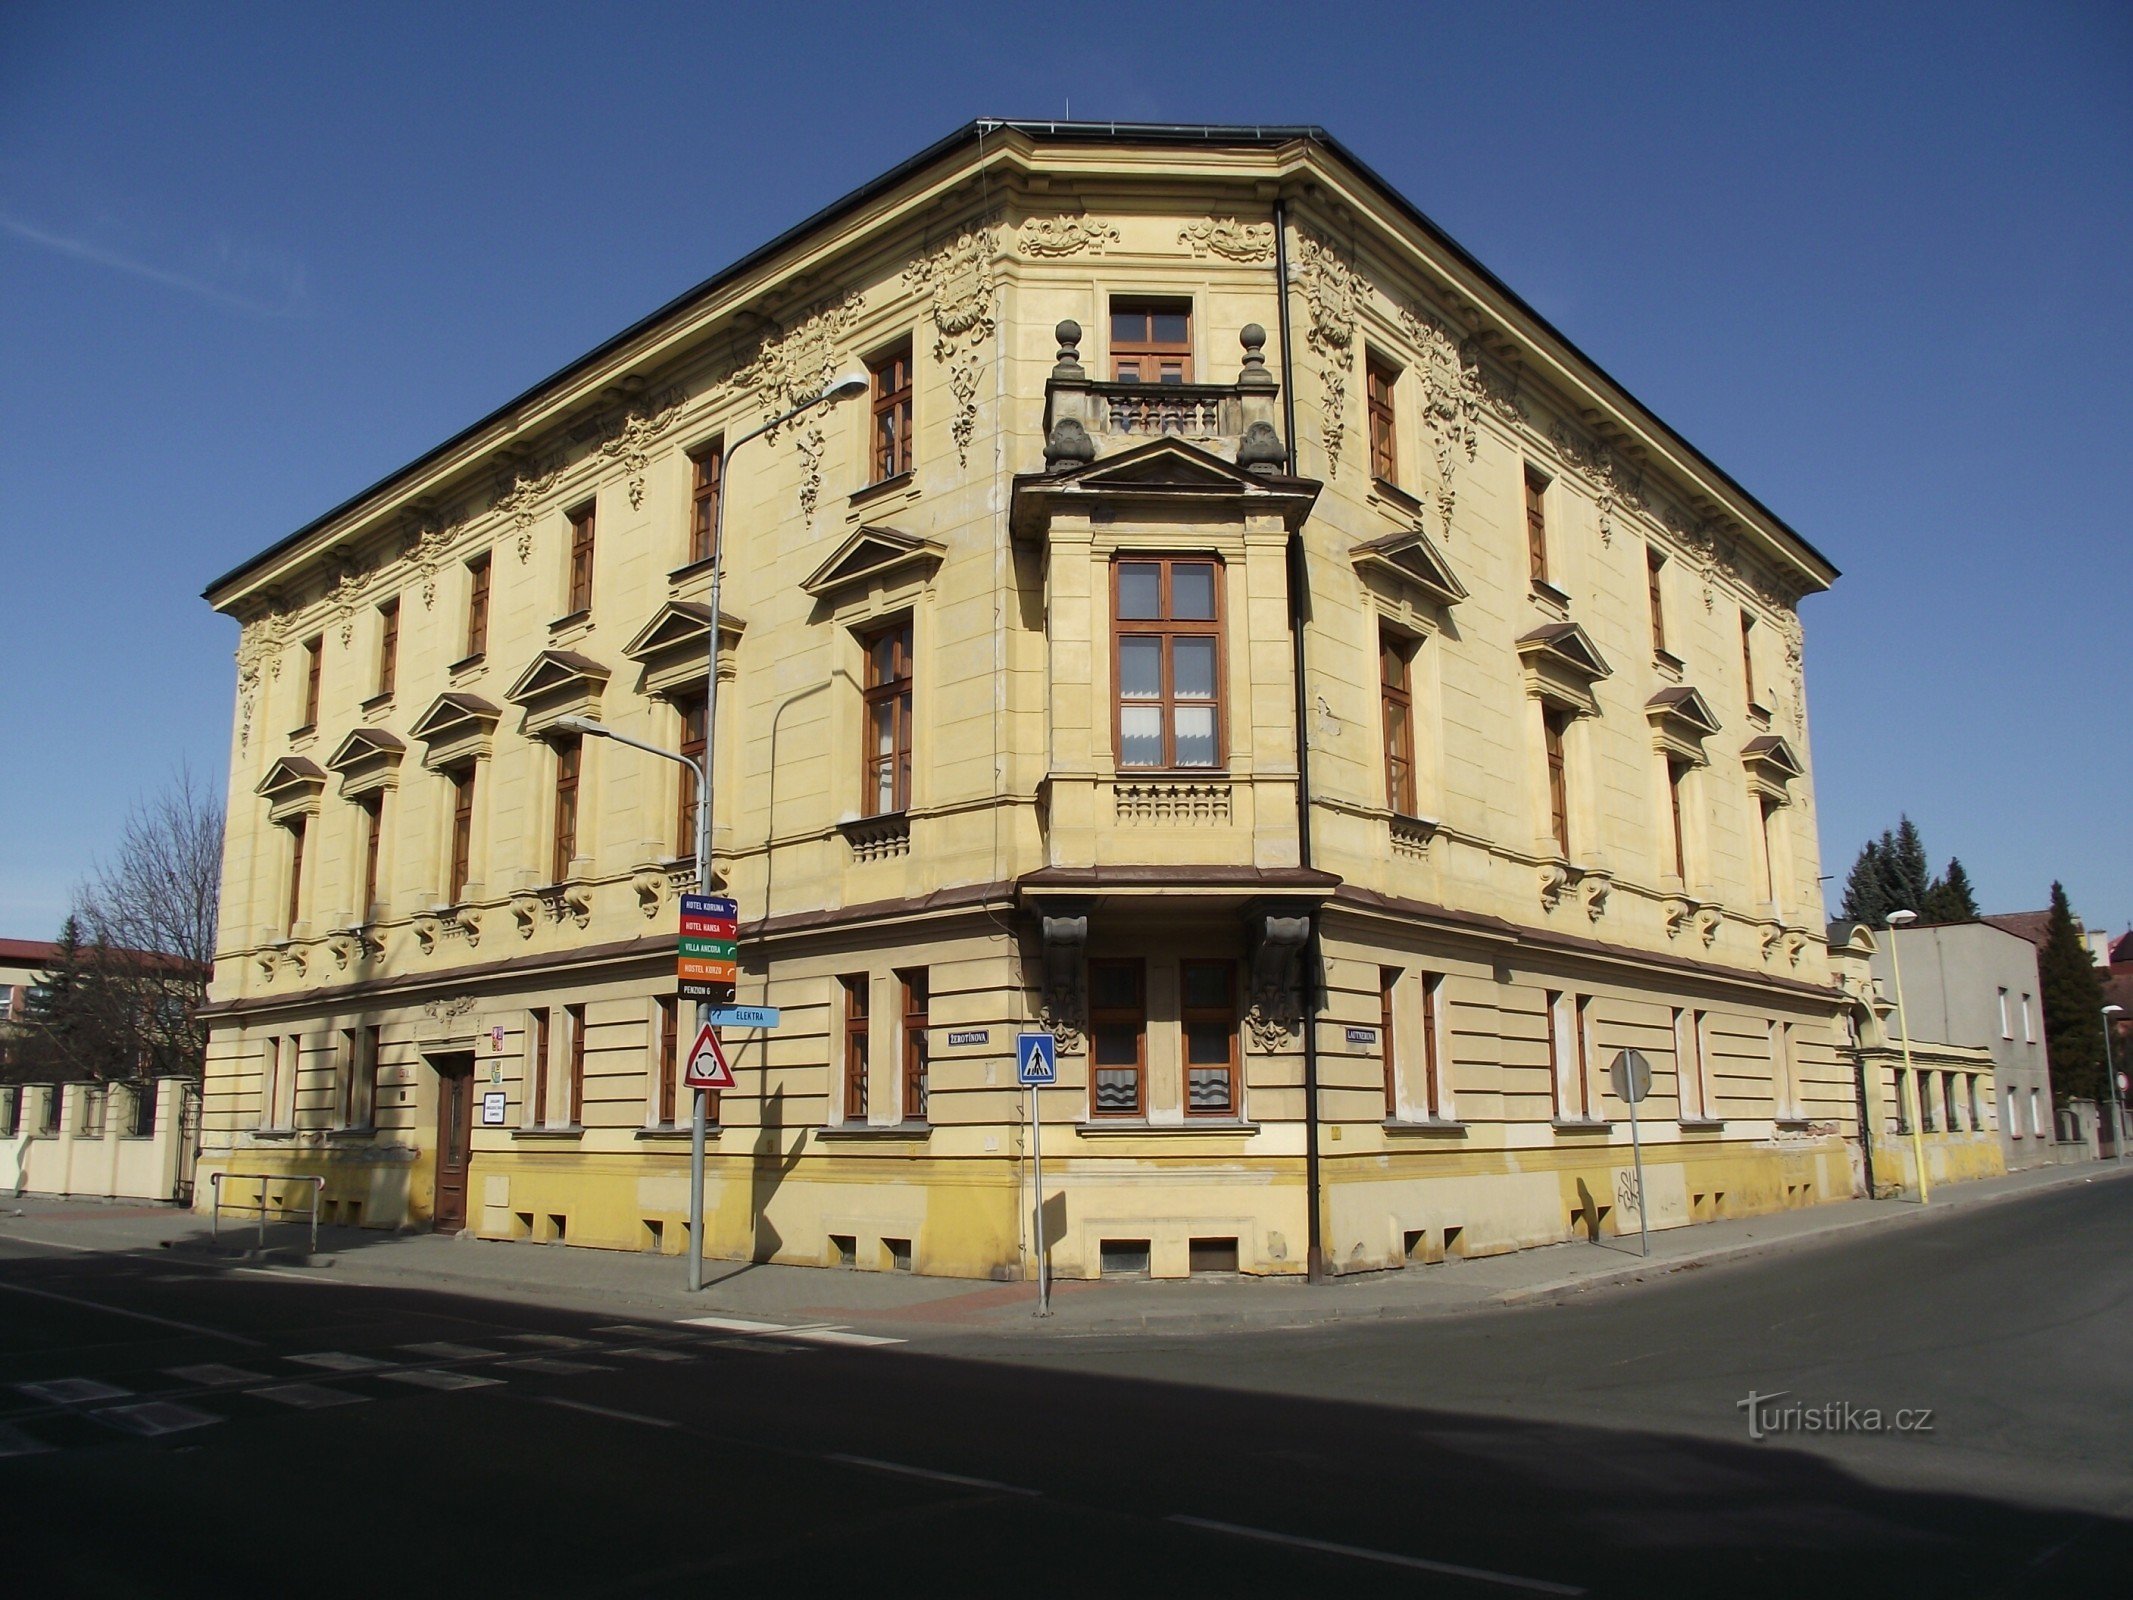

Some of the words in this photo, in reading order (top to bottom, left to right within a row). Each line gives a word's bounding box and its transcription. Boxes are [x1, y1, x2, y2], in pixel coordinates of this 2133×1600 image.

[686, 901, 702, 911] HOTEL
[703, 903, 724, 912] KORUNA
[685, 922, 702, 931] HOTEL
[703, 923, 720, 932] HANSA
[685, 943, 700, 952] VILLA
[684, 964, 704, 974] HOSTEL
[705, 966, 722, 975] KORZO
[683, 985, 706, 994] PENZION
[736, 1010, 764, 1021] ELEKTRA
[950, 1032, 986, 1043] ŽEROTÍNOVA
